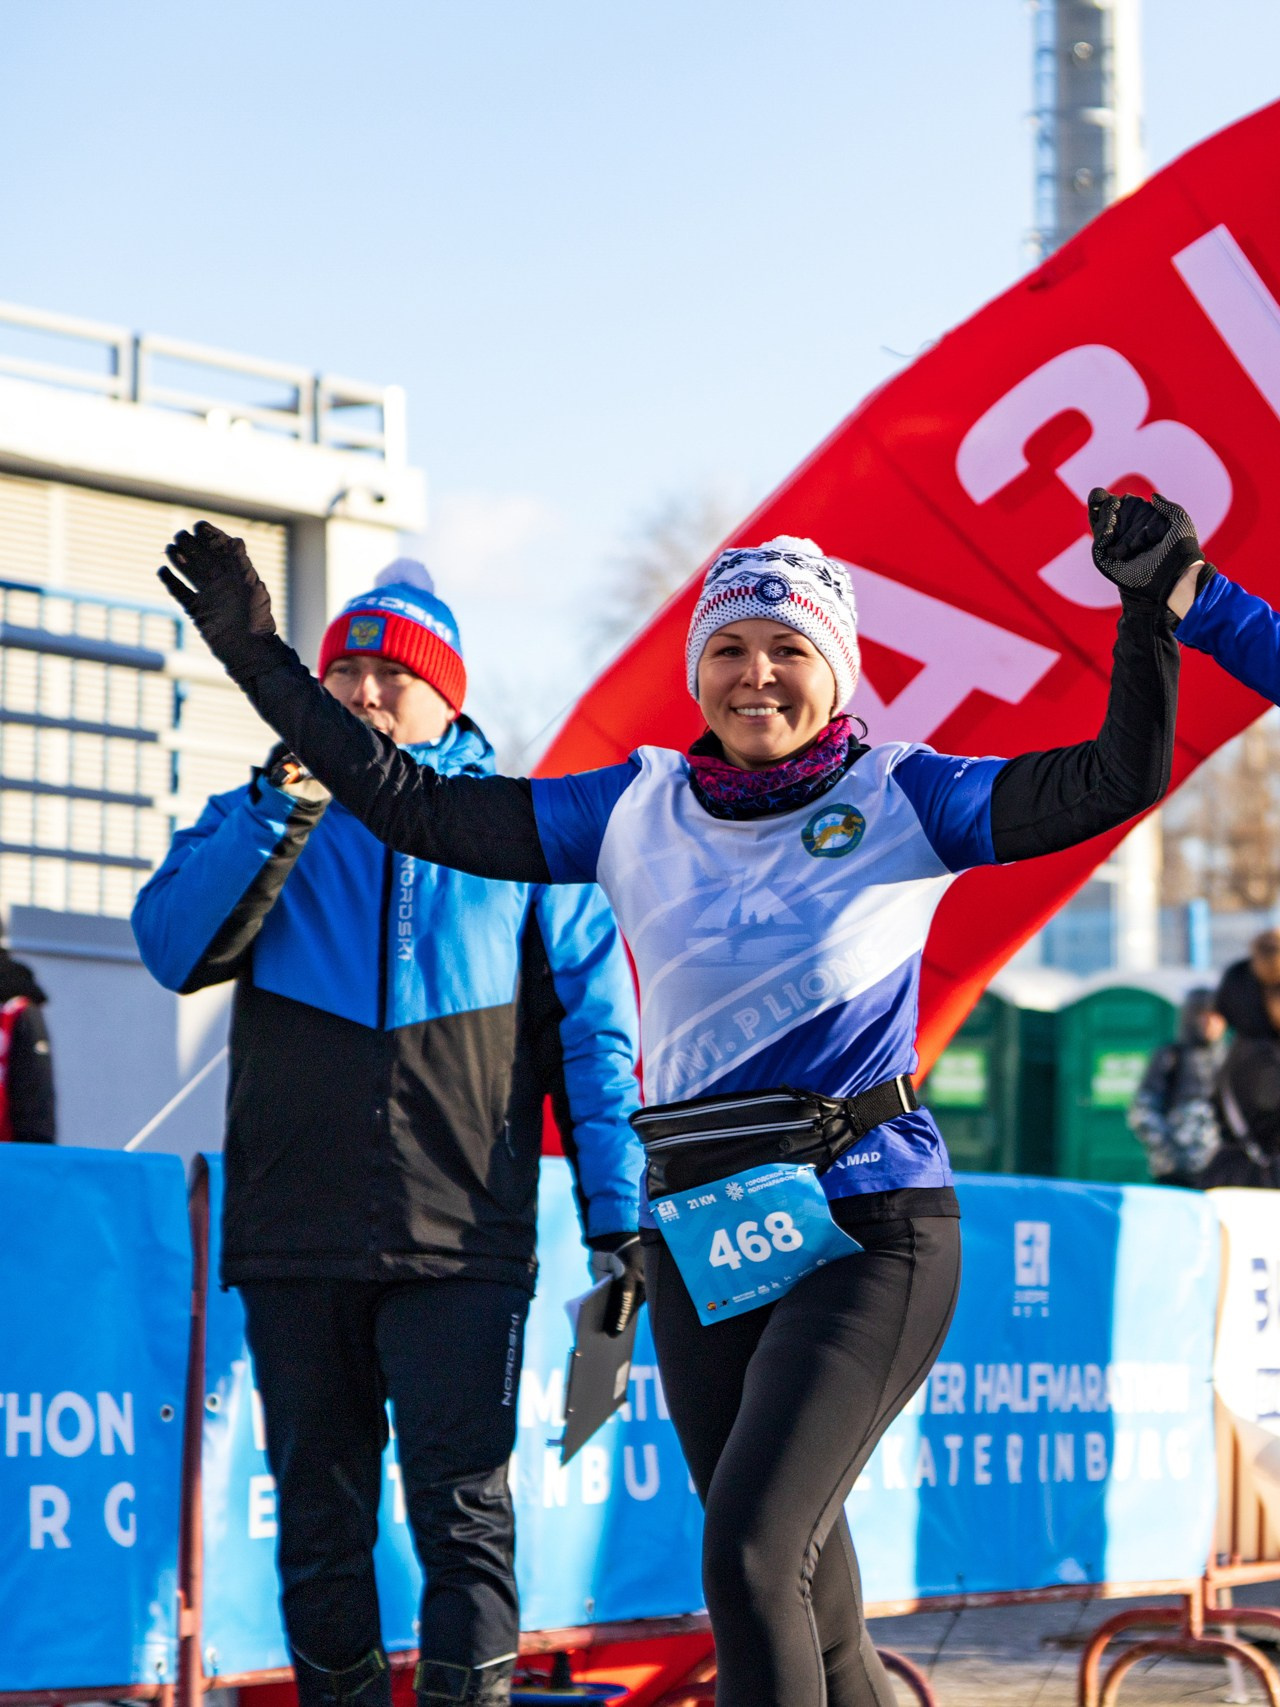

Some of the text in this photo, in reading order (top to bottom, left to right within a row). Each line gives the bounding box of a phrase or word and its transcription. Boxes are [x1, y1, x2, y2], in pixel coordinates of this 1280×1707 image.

[396, 854, 416, 961] NORDSKI
[847, 1151, 881, 1167] MAD
[708, 1211, 804, 1270] 468
[501, 1312, 520, 1407] NORDSKI
[0, 1391, 136, 1457] HON
